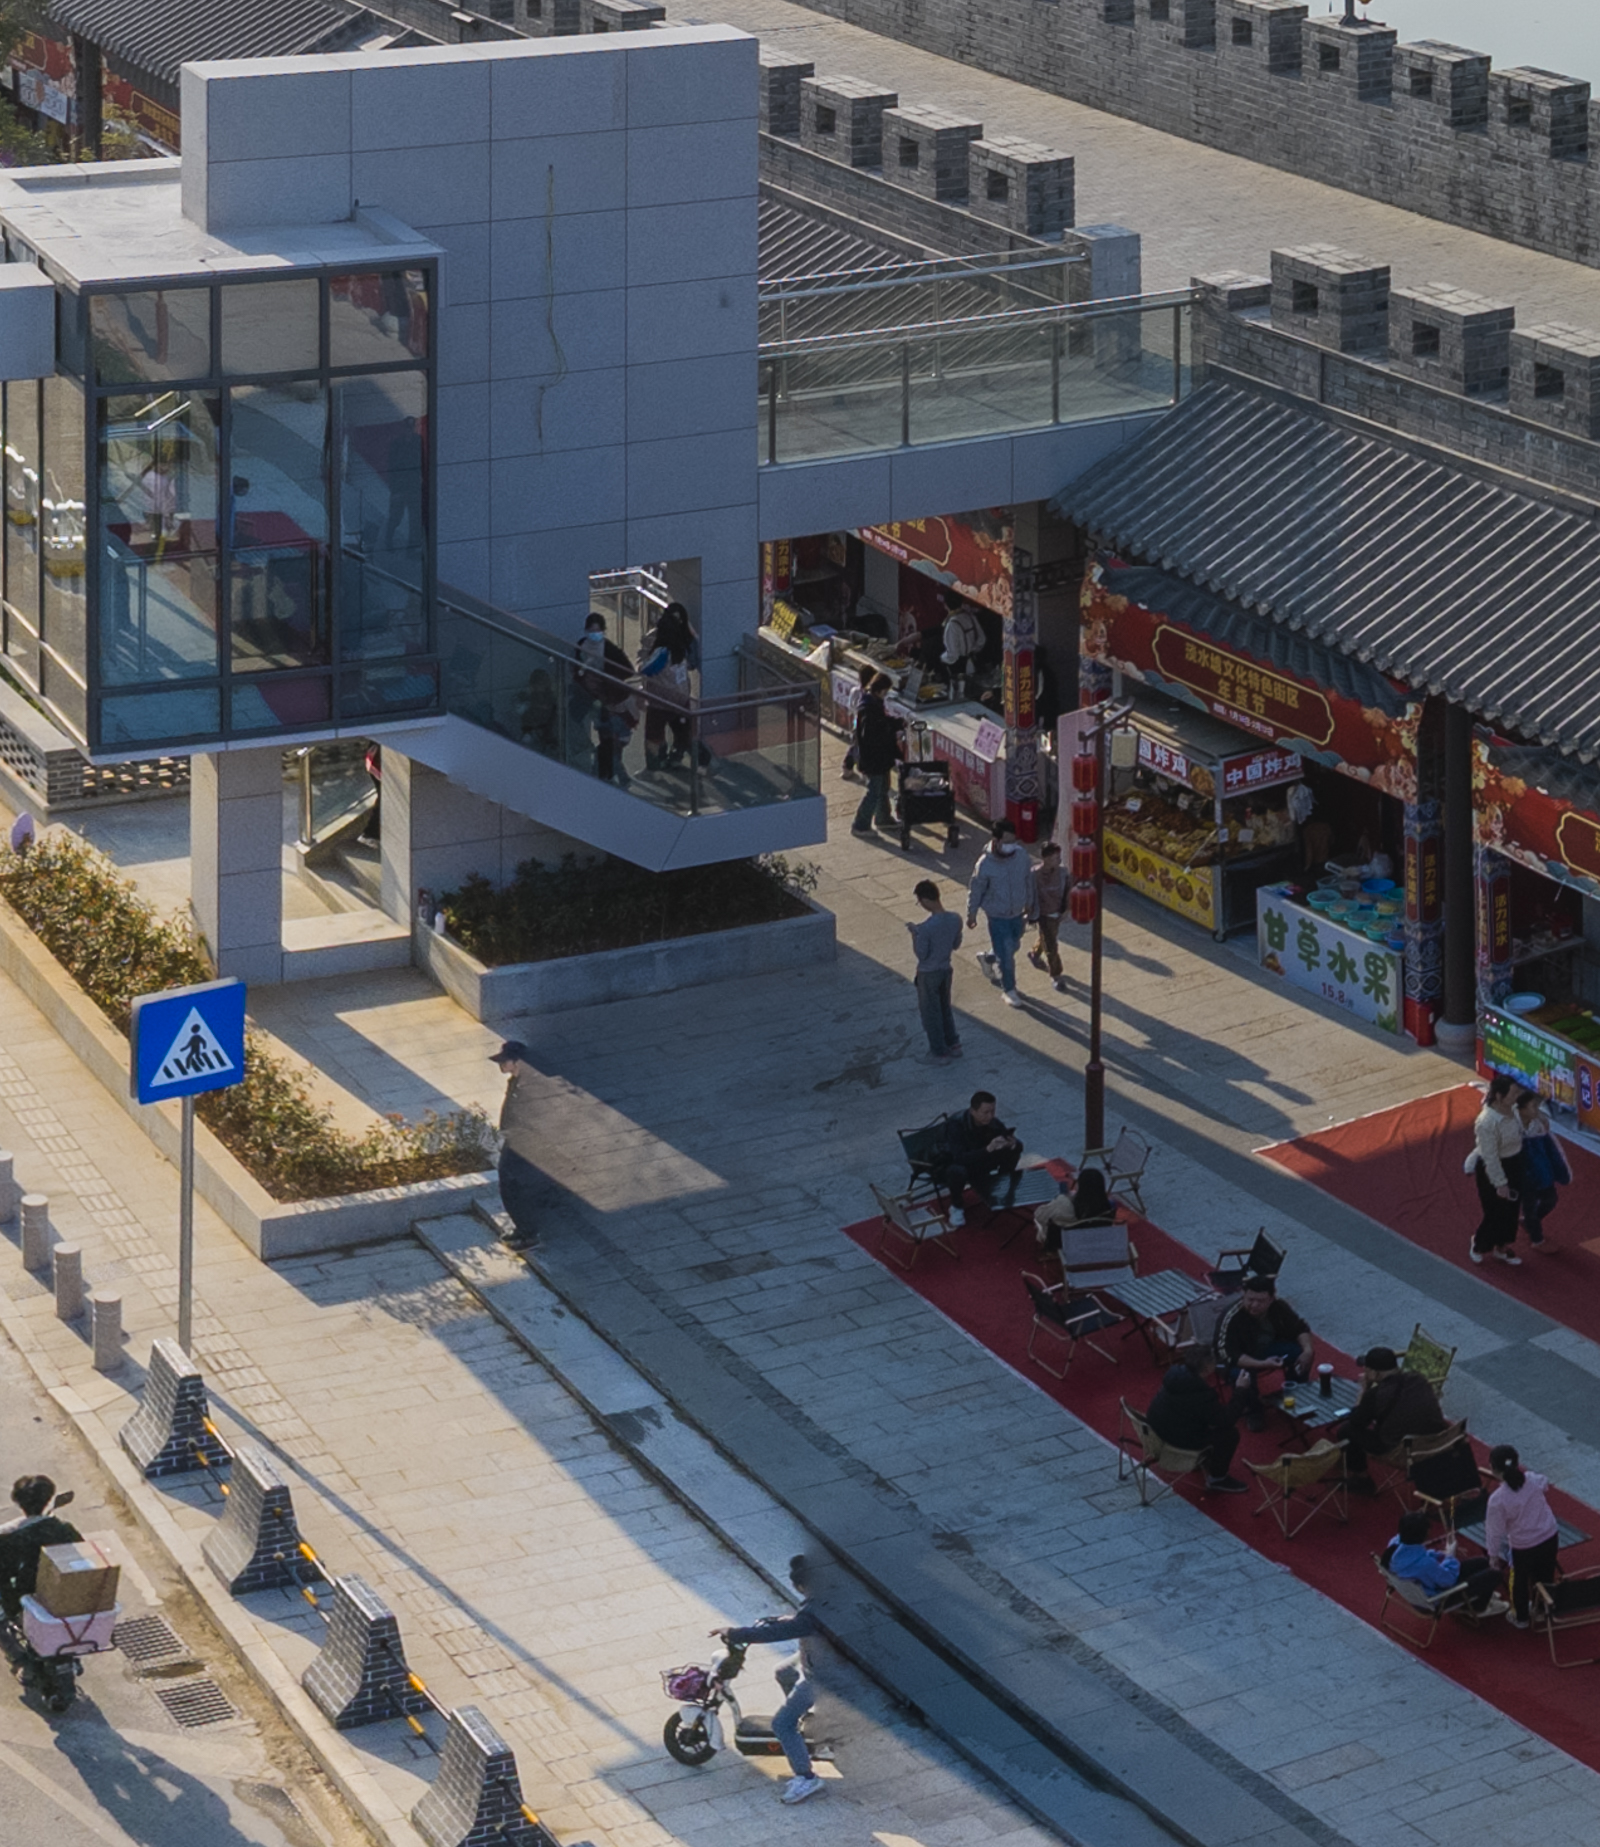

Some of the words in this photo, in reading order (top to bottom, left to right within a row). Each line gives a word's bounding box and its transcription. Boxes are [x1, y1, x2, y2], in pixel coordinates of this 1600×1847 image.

[1226, 753, 1302, 784] 中国炸鸡
[1263, 907, 1390, 1006] 甘草水果
